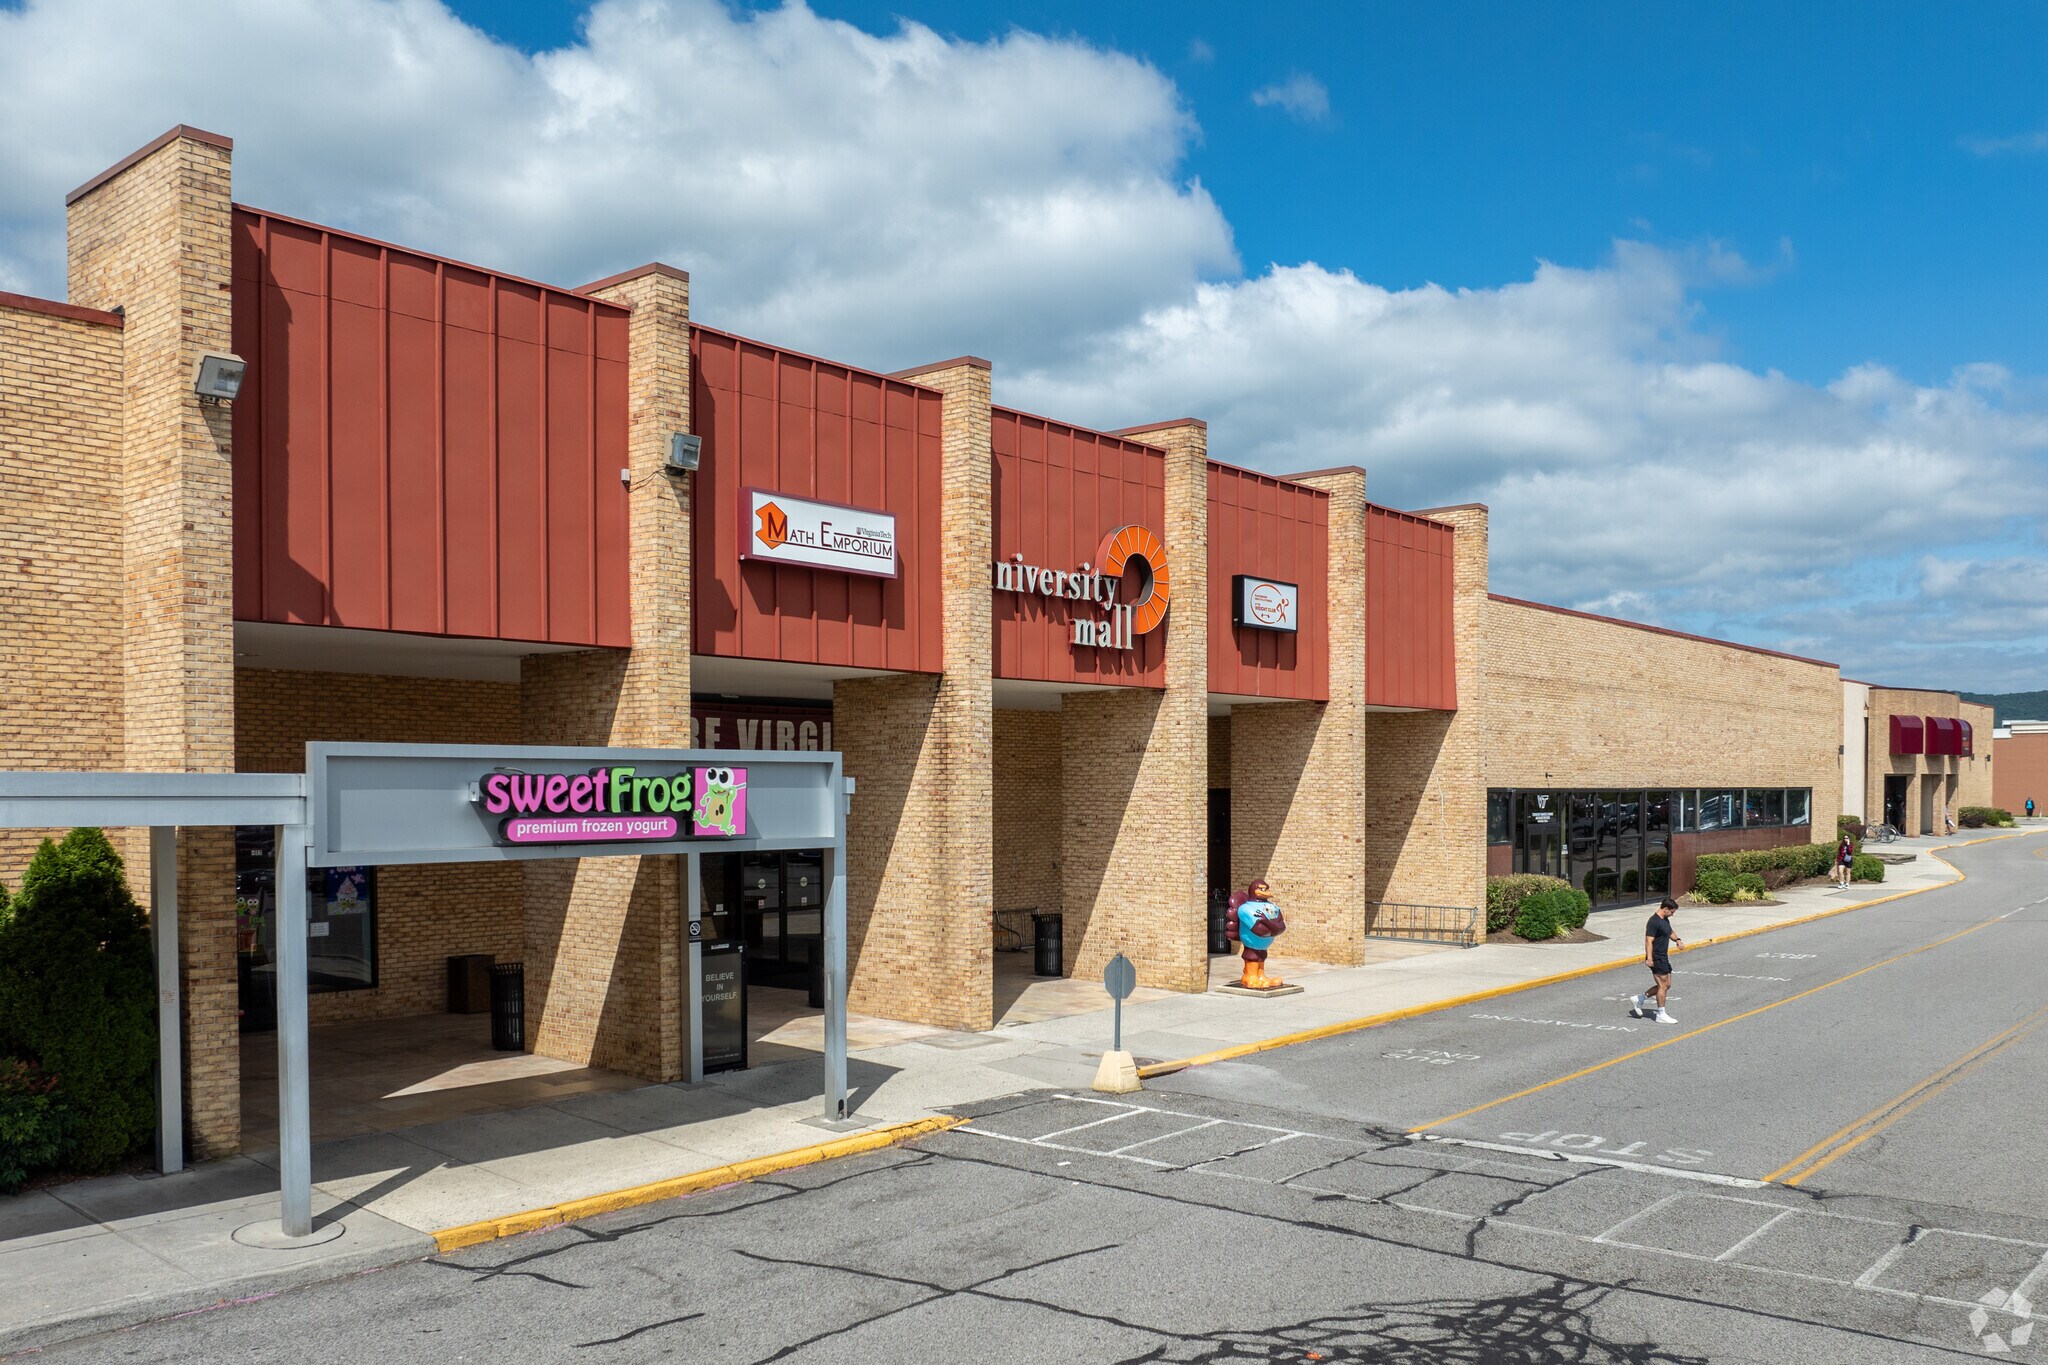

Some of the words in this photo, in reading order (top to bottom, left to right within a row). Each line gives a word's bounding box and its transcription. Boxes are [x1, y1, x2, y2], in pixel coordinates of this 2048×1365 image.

[768, 512, 815, 545] MATH
[821, 521, 892, 557] EMPORIUM
[996, 552, 1118, 611] niversity
[1073, 603, 1134, 650] mall
[486, 766, 692, 814] sweetFrog
[516, 820, 578, 838] premium
[581, 820, 623, 833] frozen
[626, 820, 668, 836] yogurt
[705, 971, 734, 982] BELIEVE
[716, 983, 724, 991] IN
[1499, 1130, 1713, 1164] STOP
